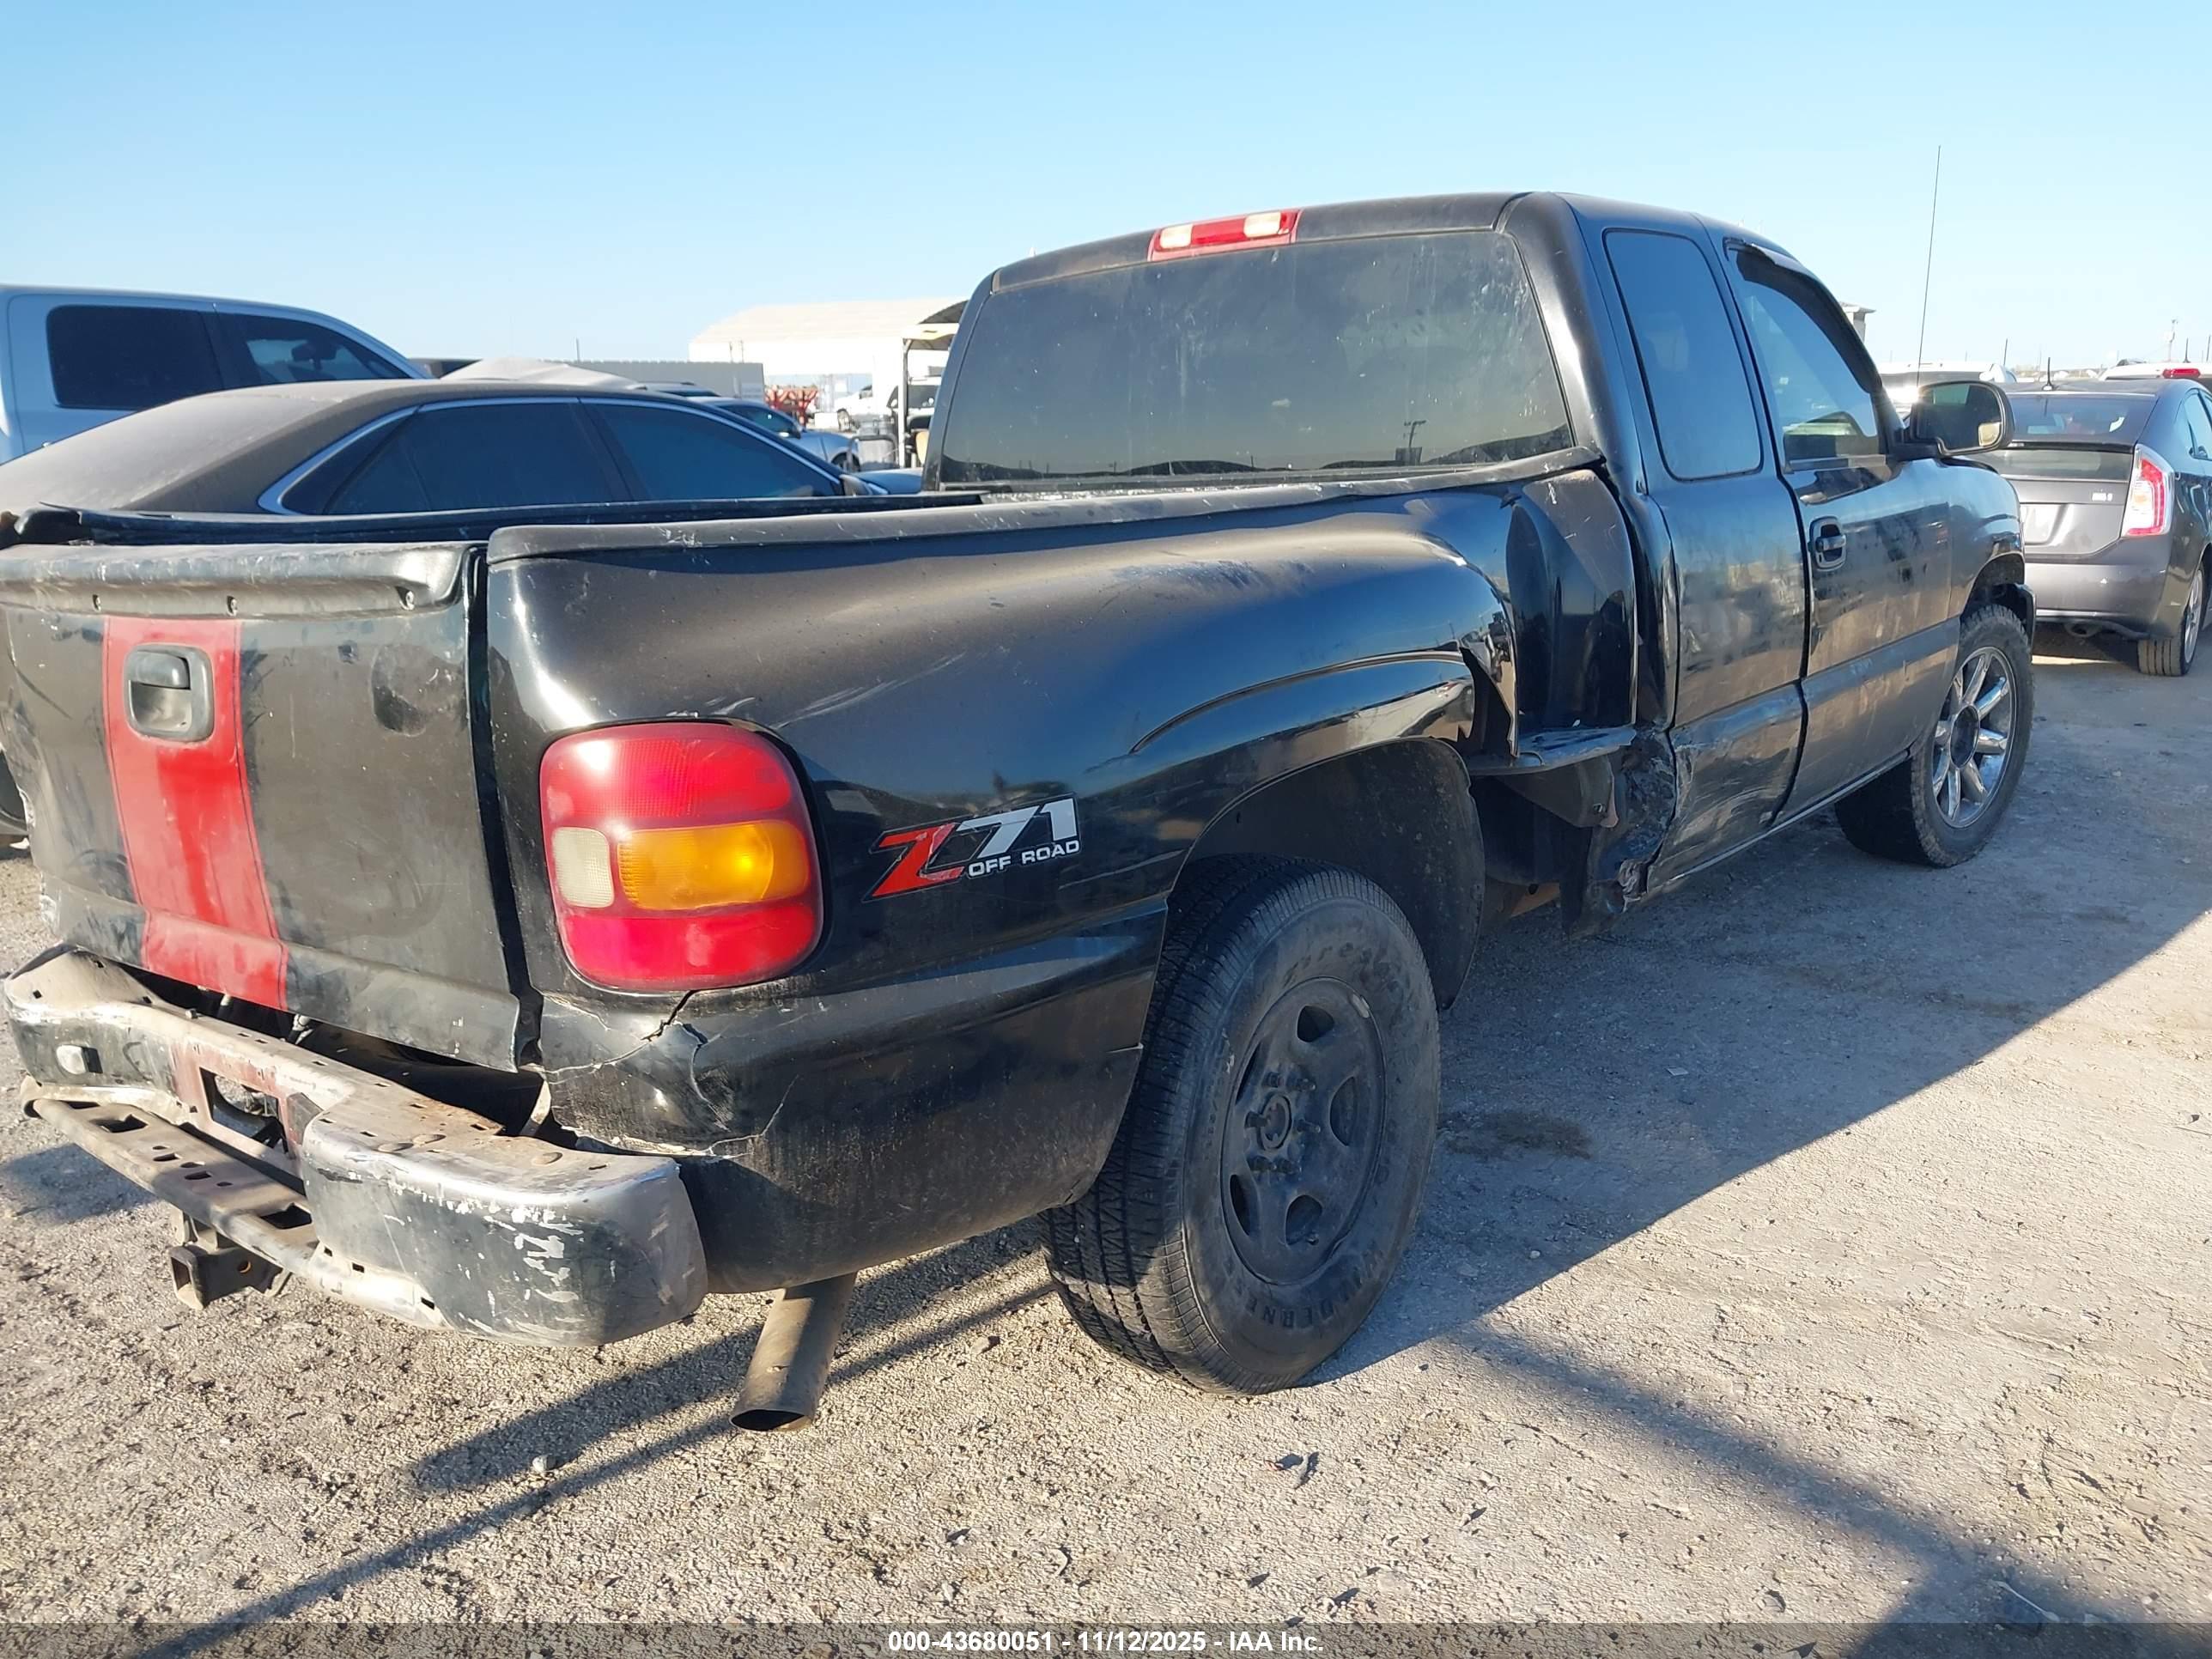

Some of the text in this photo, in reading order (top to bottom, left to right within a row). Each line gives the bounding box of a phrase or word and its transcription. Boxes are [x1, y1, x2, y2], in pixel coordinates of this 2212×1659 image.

[872, 798, 1078, 897] Z71
[968, 840, 1080, 877] OFF ROAD
